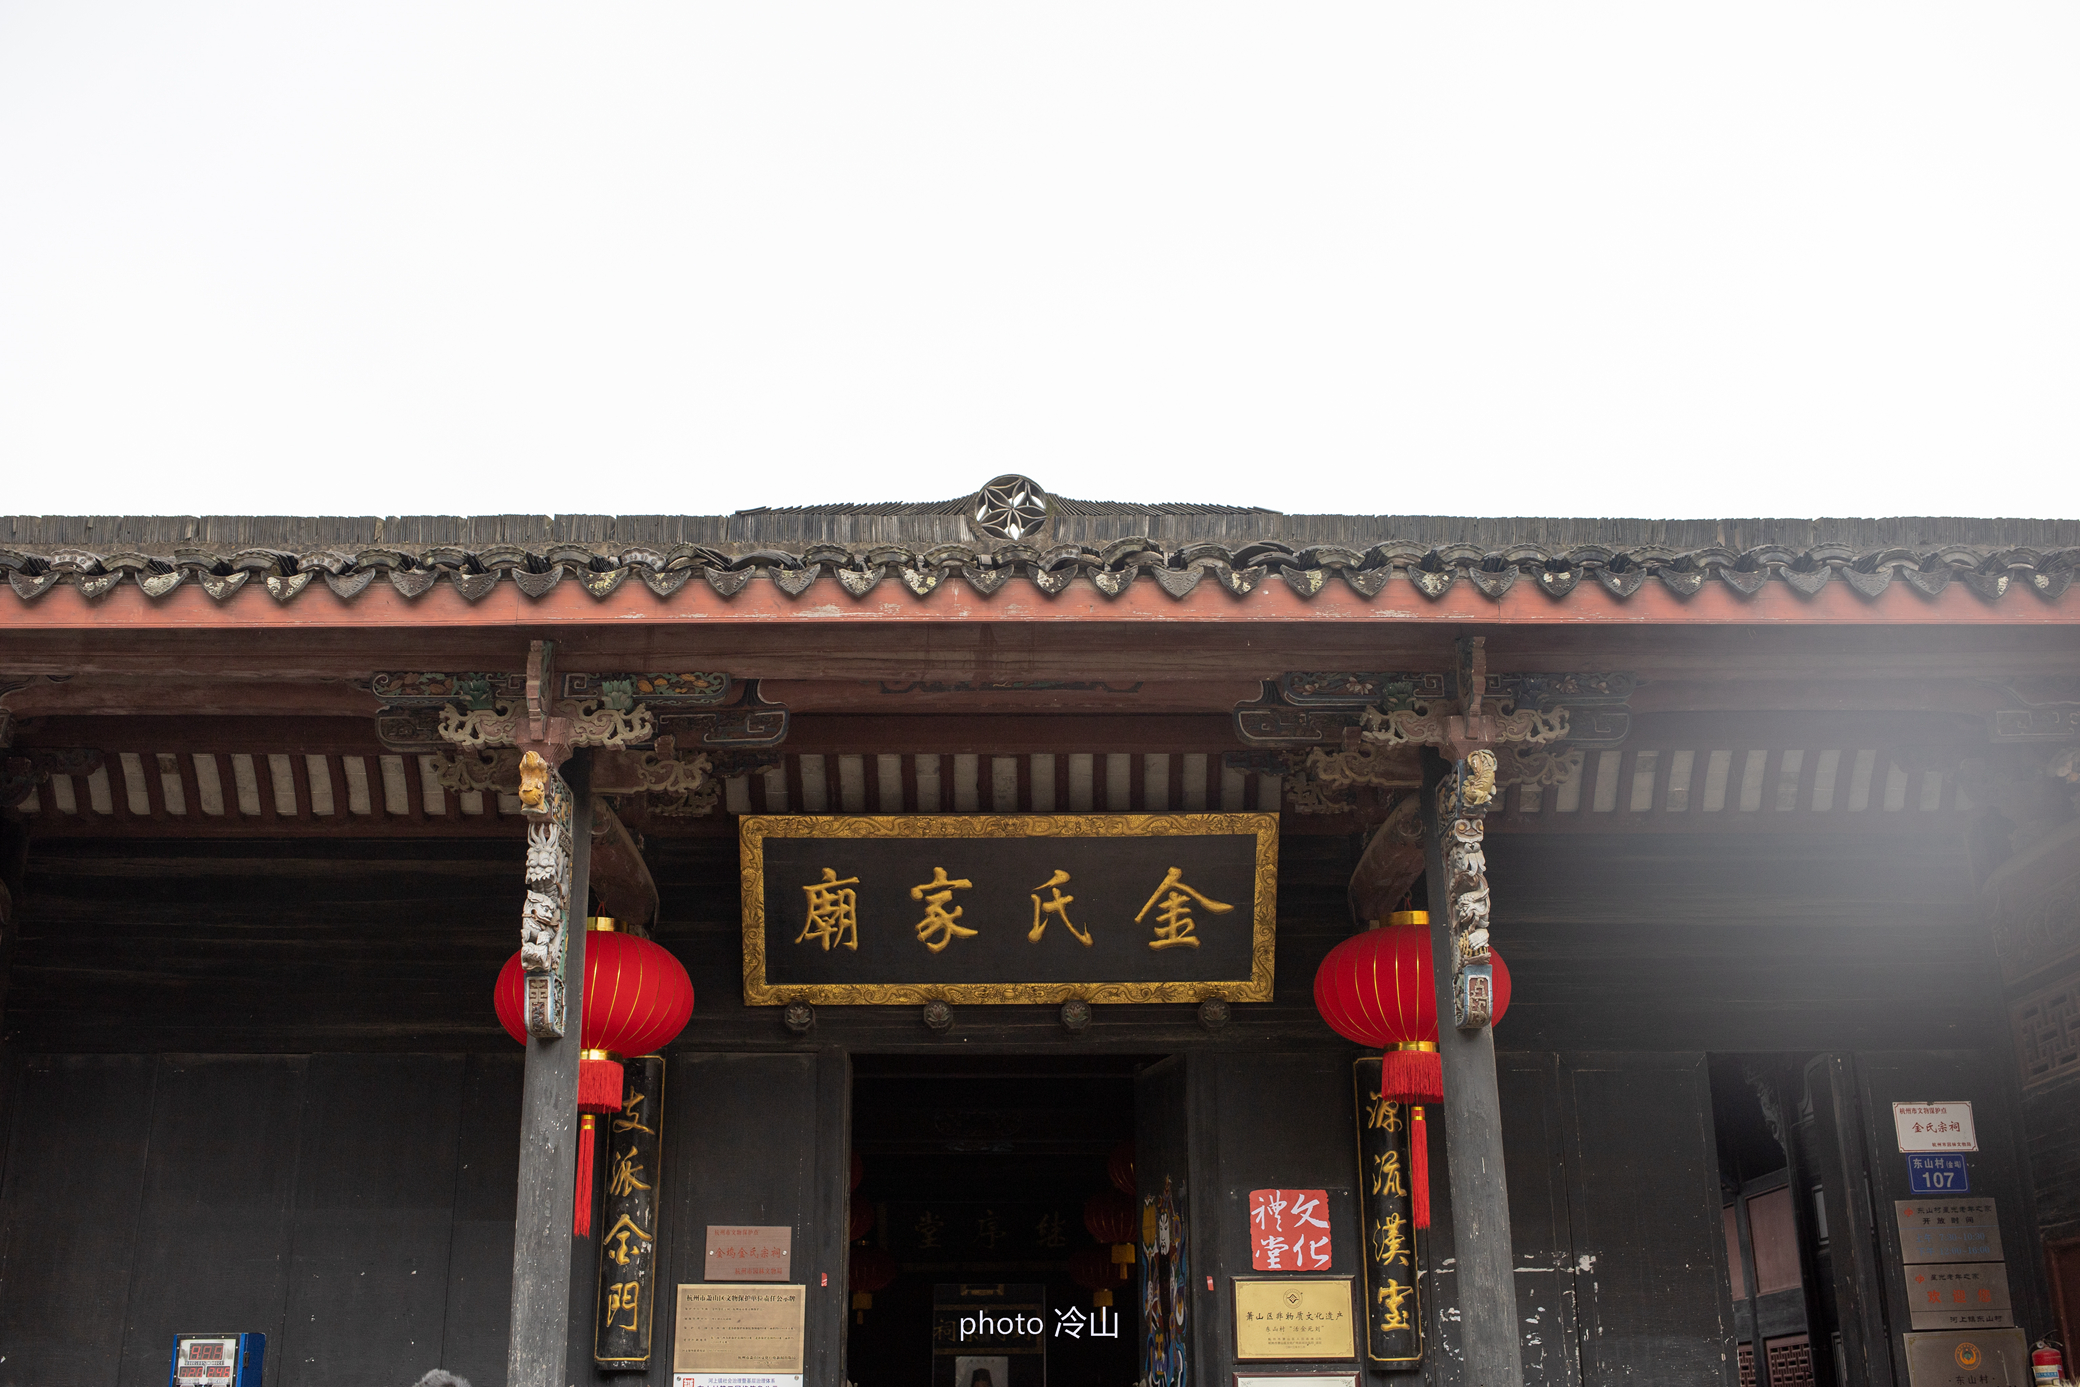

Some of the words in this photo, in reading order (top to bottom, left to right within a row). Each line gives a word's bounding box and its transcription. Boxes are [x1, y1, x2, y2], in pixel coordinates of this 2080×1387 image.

[795, 867, 1234, 952] 金氏家廟
[1912, 1121, 1961, 1133] 金氏宗祠
[1922, 1172, 1954, 1188] 107
[1917, 1205, 1992, 1214] 东山村星光老年之家
[1923, 1217, 1974, 1225] 开放时间
[1916, 1233, 1932, 1243] 上午
[715, 1246, 781, 1259] 金坞金氏宗祠
[1916, 1247, 1934, 1256] 下午
[1930, 1273, 1979, 1281] 星光老年之家
[1927, 1289, 1991, 1304] 欢迎您
[1246, 1311, 1343, 1321] 萧山区非物质文化遗产
[1950, 1316, 2002, 1324] 河上镇东山村
